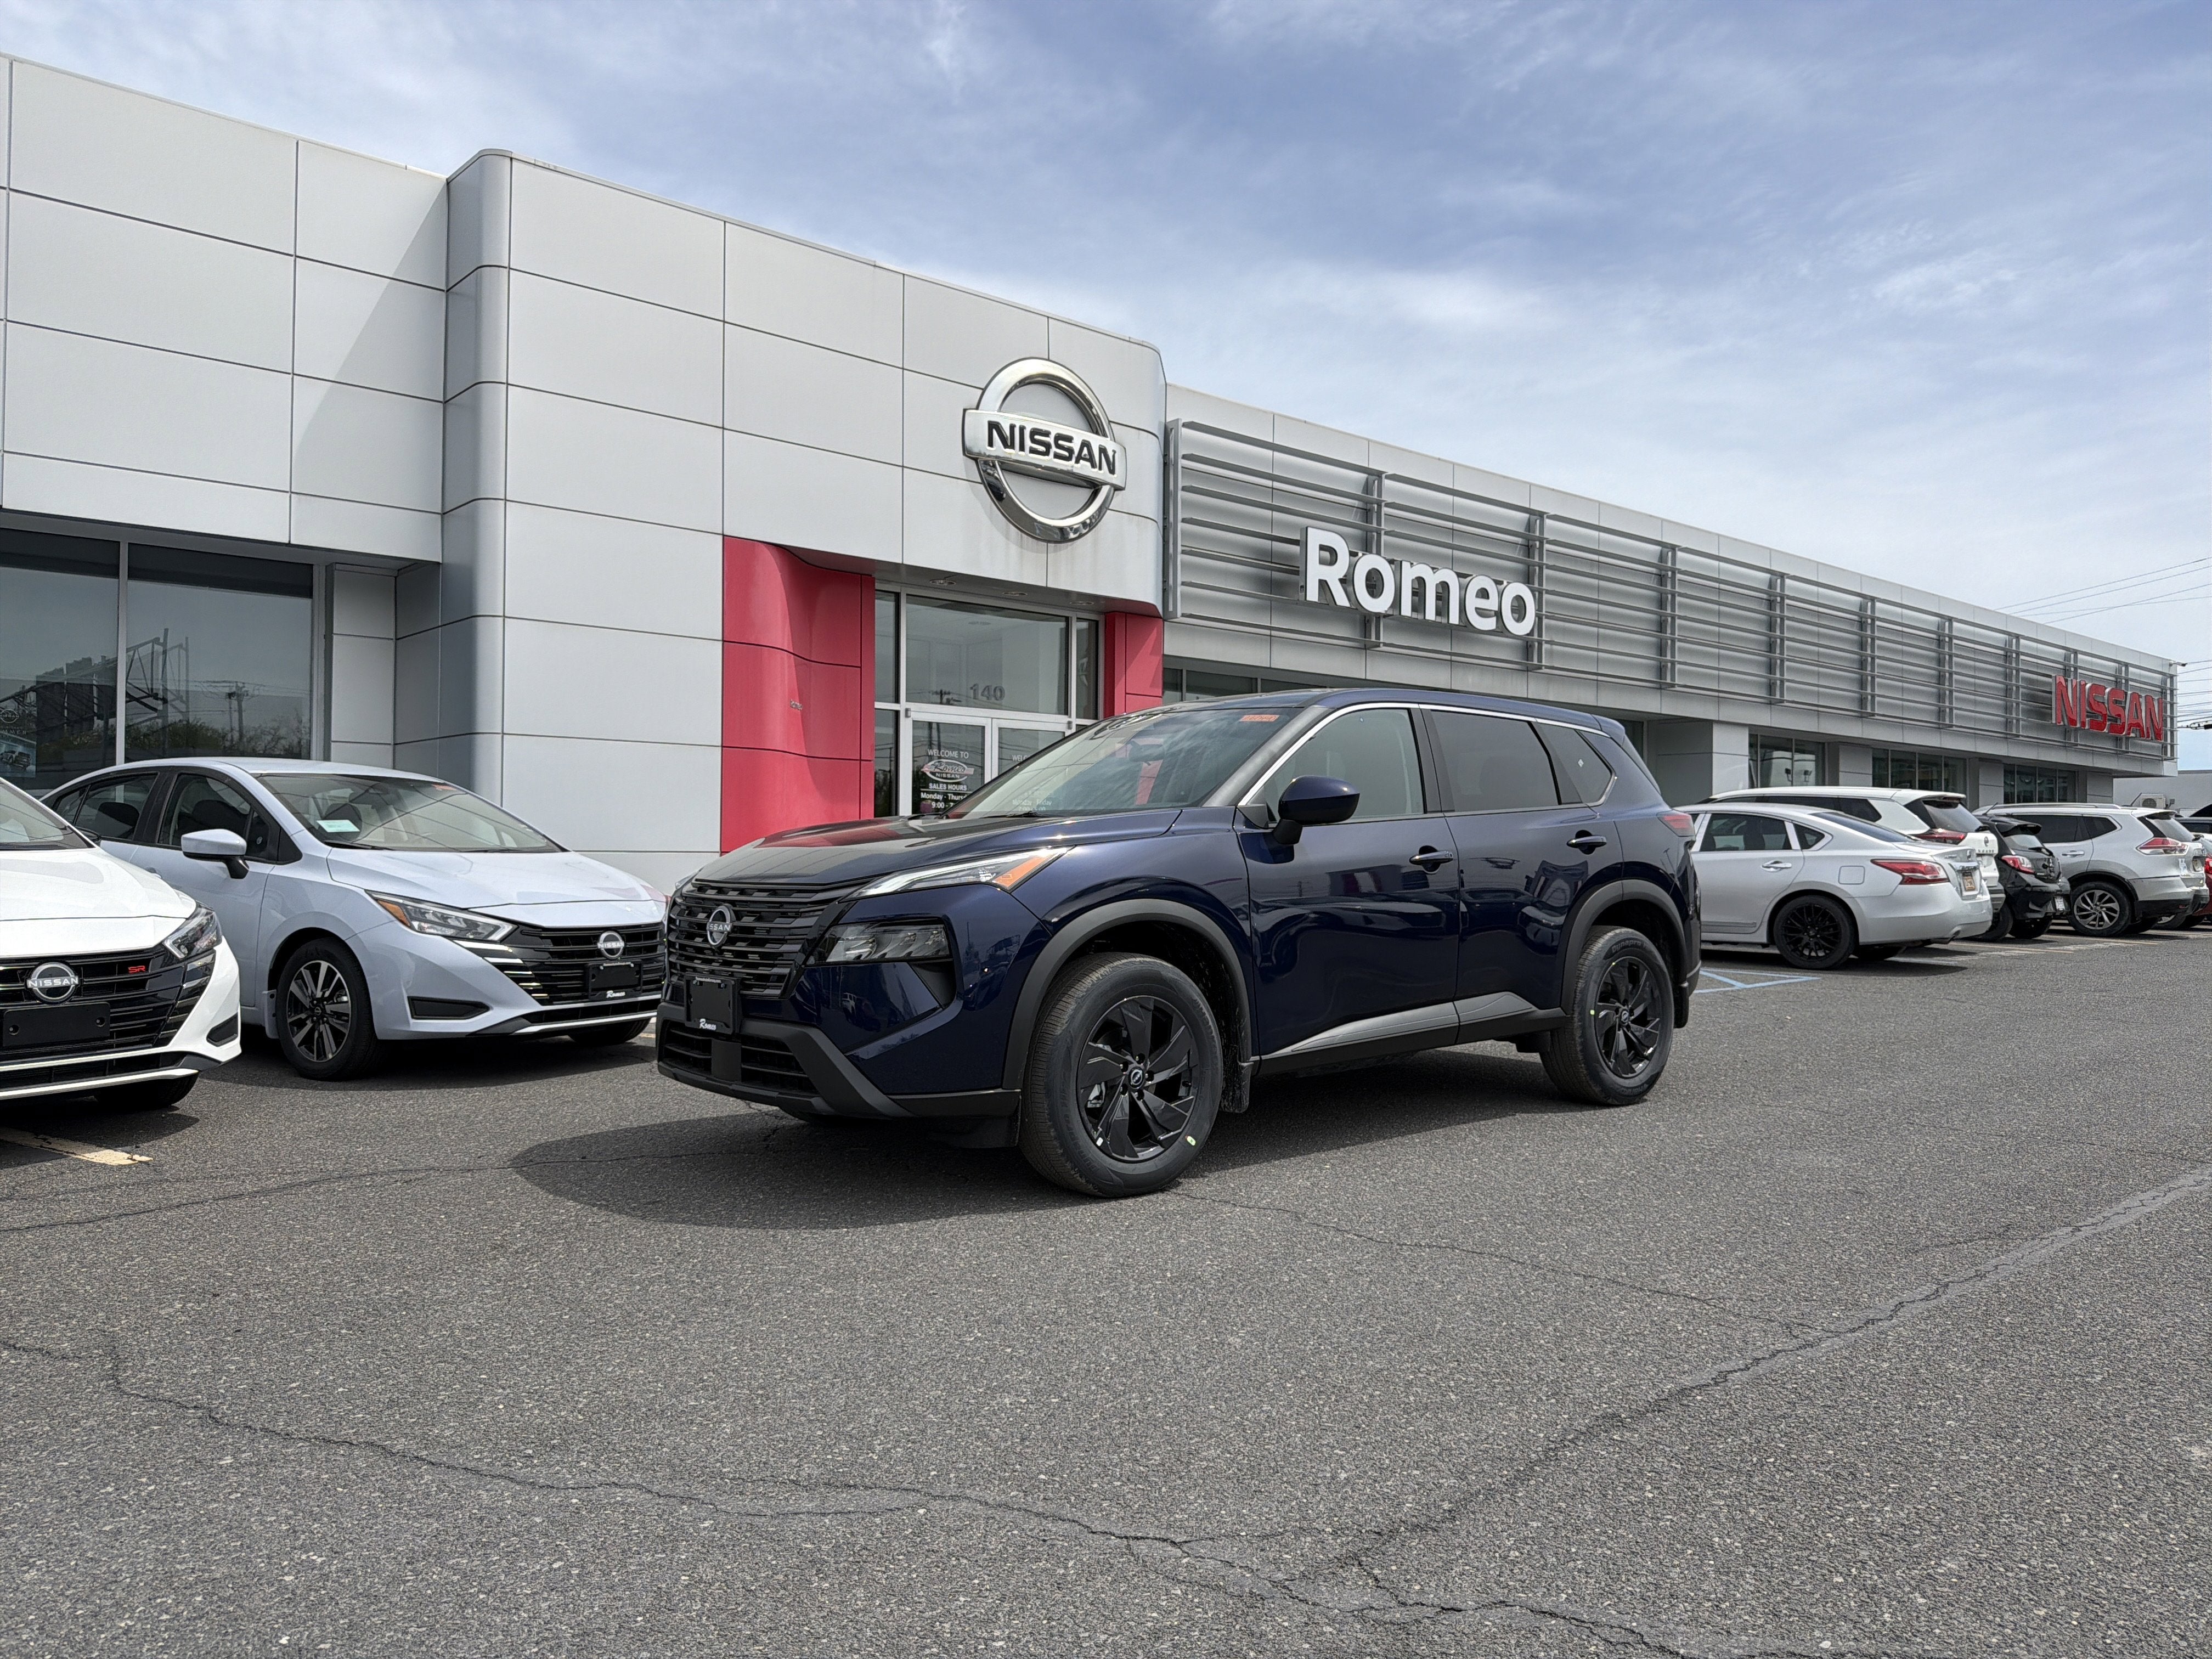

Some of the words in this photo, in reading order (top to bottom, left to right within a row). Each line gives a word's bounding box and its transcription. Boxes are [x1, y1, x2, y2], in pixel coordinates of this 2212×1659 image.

[987, 420, 1117, 476] NISSAN
[1302, 526, 1536, 636] Romeo
[973, 684, 1005, 701] 140
[2053, 675, 2163, 742] NISSAN
[928, 749, 958, 758] WELCOME
[930, 761, 966, 772] Romeo
[921, 792, 943, 800] Monday
[28, 978, 78, 988] NISSAN
